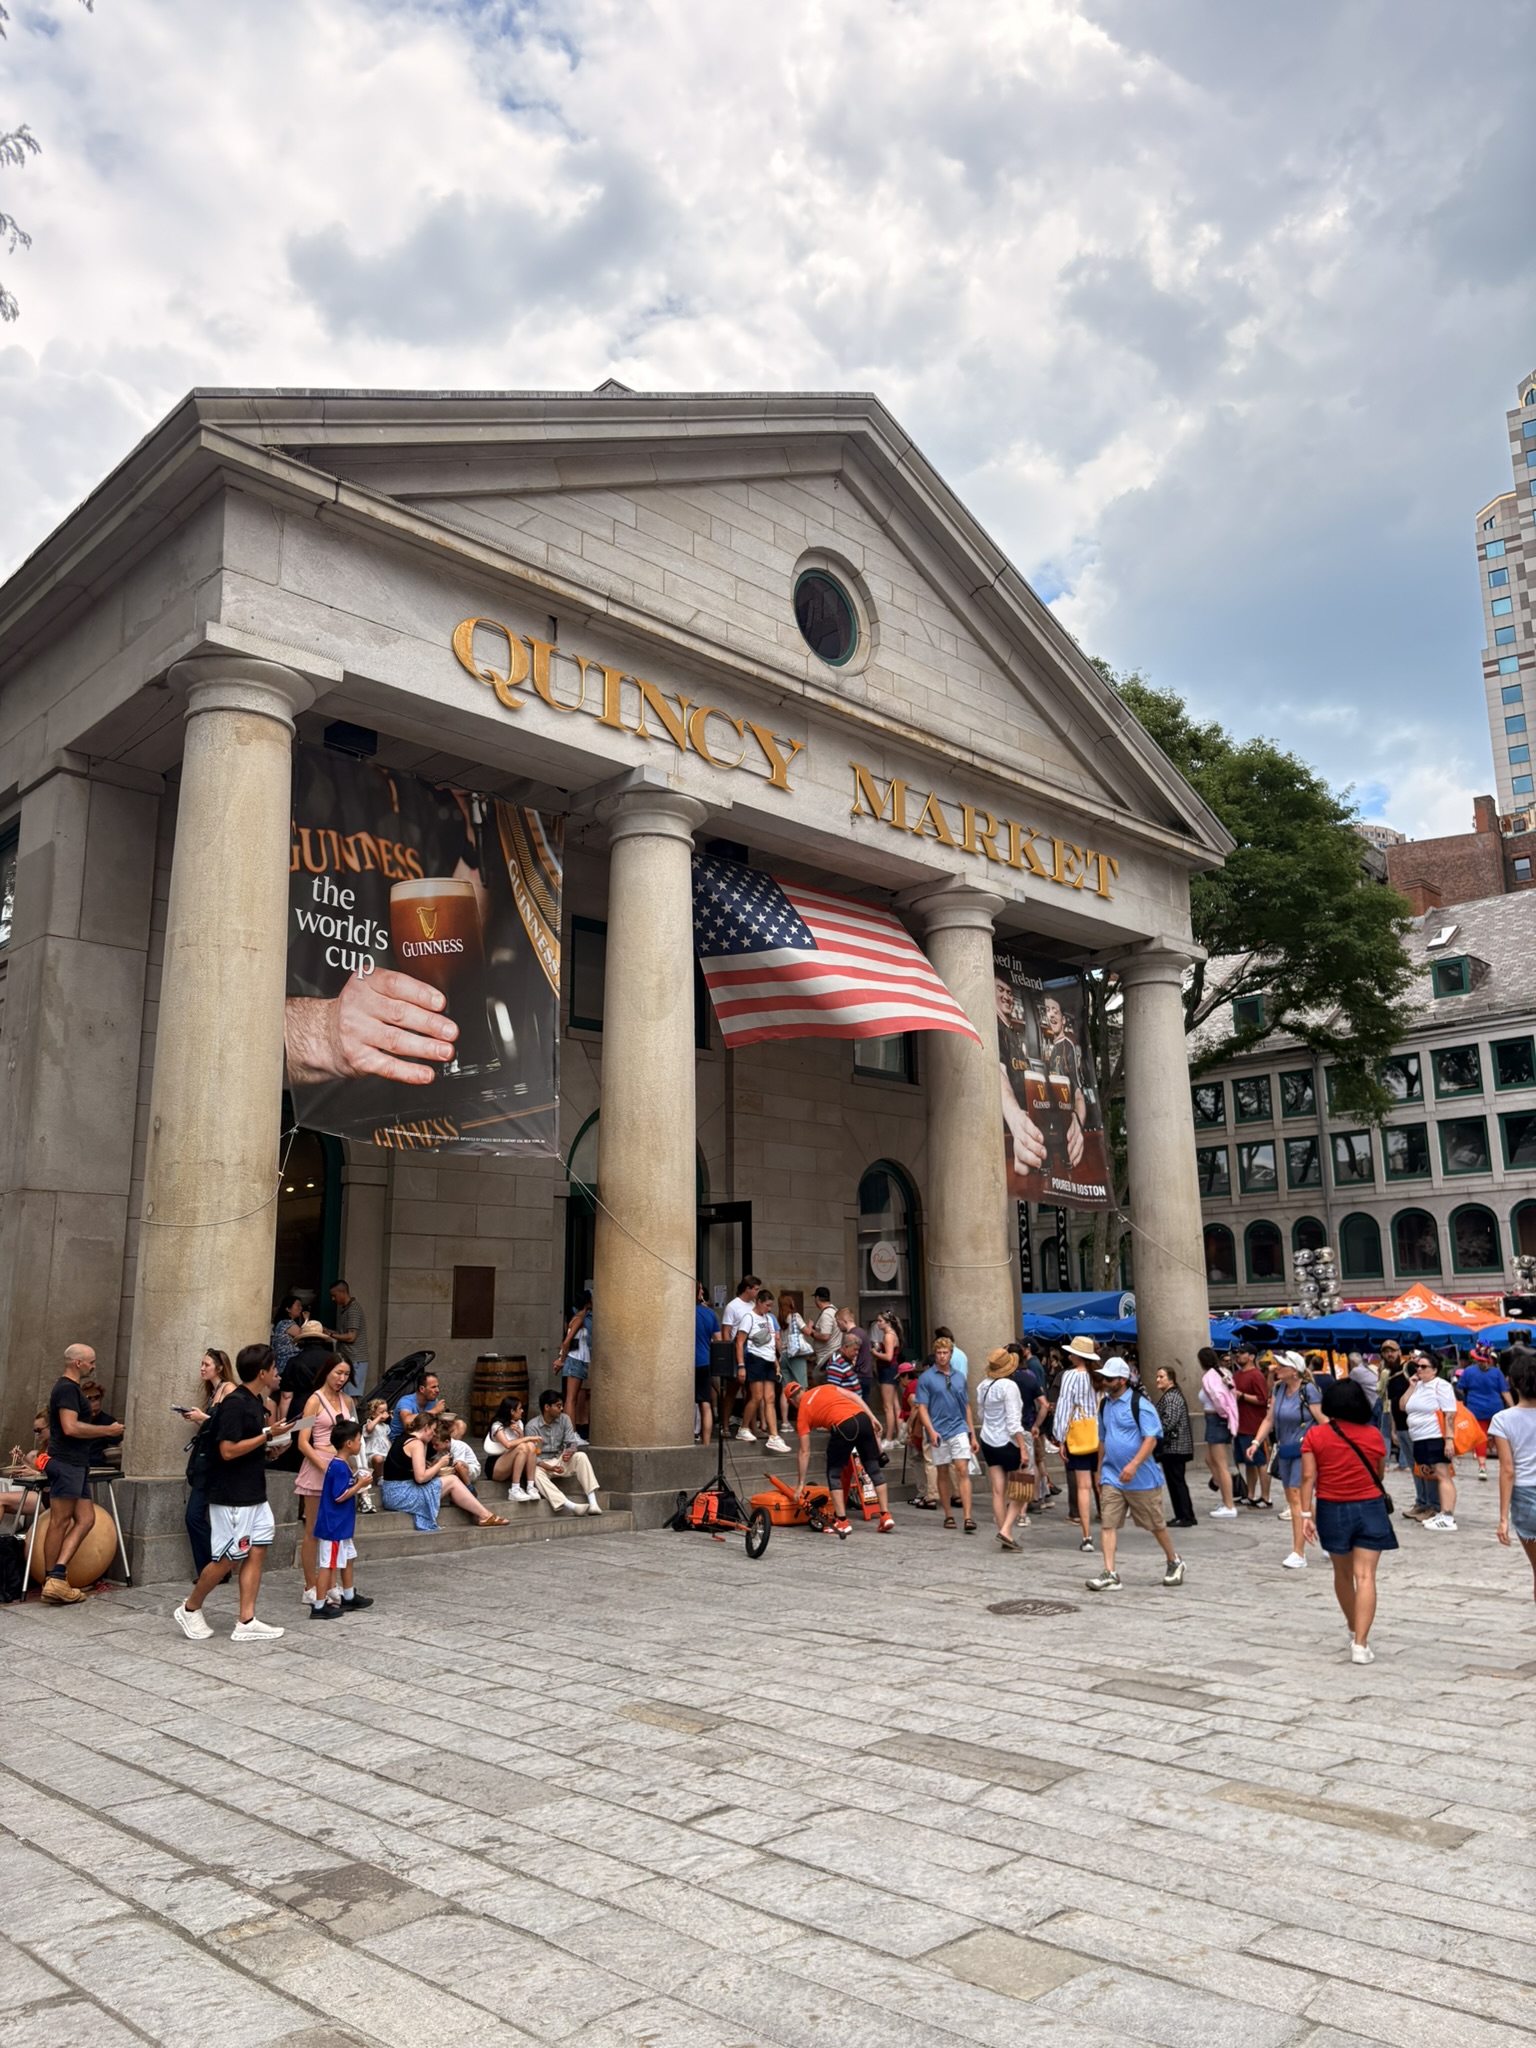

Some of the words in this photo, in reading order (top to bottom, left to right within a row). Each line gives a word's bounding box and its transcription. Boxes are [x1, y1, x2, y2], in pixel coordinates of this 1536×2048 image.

[452, 616, 806, 792] QUINCY
[848, 761, 1120, 900] MARKET
[312, 875, 355, 910] the
[295, 907, 389, 950] world's
[507, 857, 560, 977] GUINNESS
[325, 945, 375, 980] cup
[402, 937, 464, 958] GUINNESS
[1012, 956, 1022, 972] in
[1010, 970, 1044, 991] Ireland
[1051, 1177, 1071, 1192] POURED
[1071, 1182, 1077, 1193] IN
[1077, 1183, 1107, 1196] BOSTON
[1057, 1207, 1068, 1280] OACH
